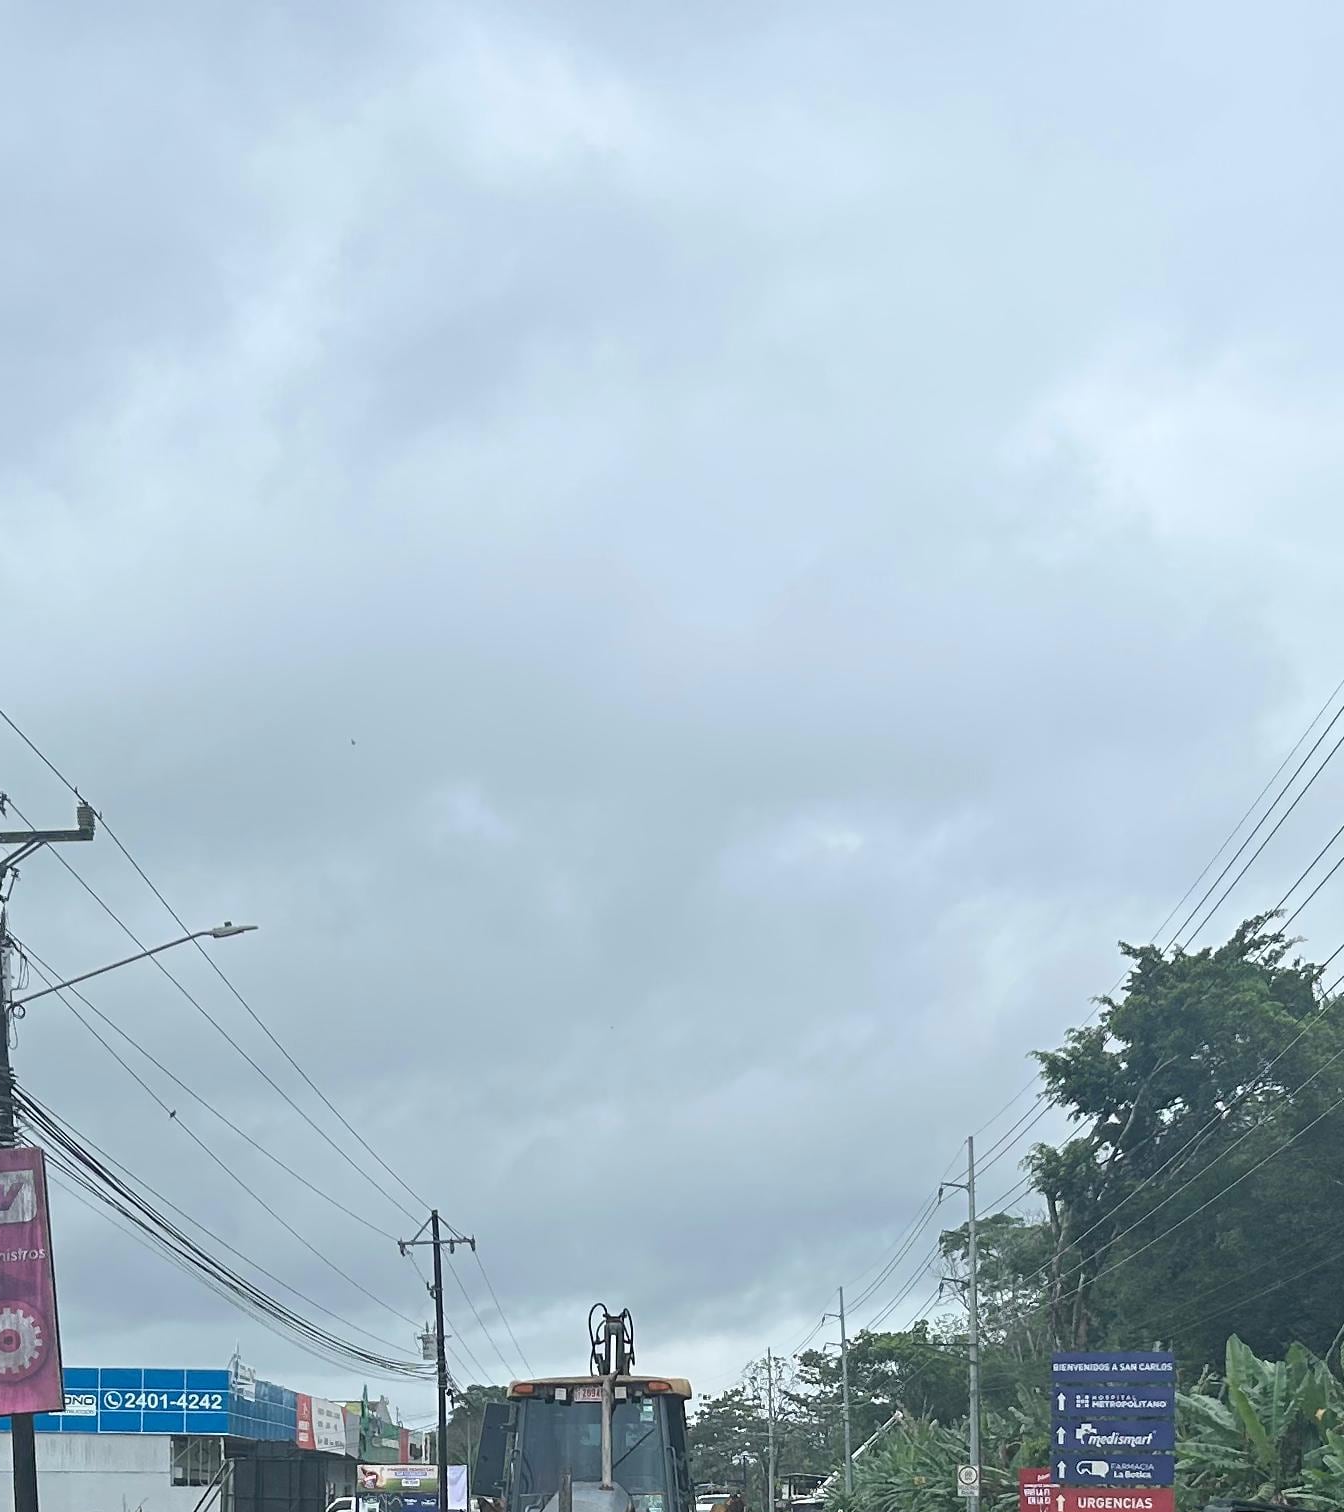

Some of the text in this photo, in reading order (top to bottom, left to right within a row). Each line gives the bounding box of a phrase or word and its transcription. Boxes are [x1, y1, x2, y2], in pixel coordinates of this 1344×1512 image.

[1053, 1363, 1172, 1371] BIENVENIDOS A SAN CARLOS
[125, 1393, 222, 1410] 2401-4242
[1088, 1431, 1153, 1447] medismart
[1125, 1471, 1152, 1479] Botica
[1078, 1497, 1153, 1509] URGENCIAS
